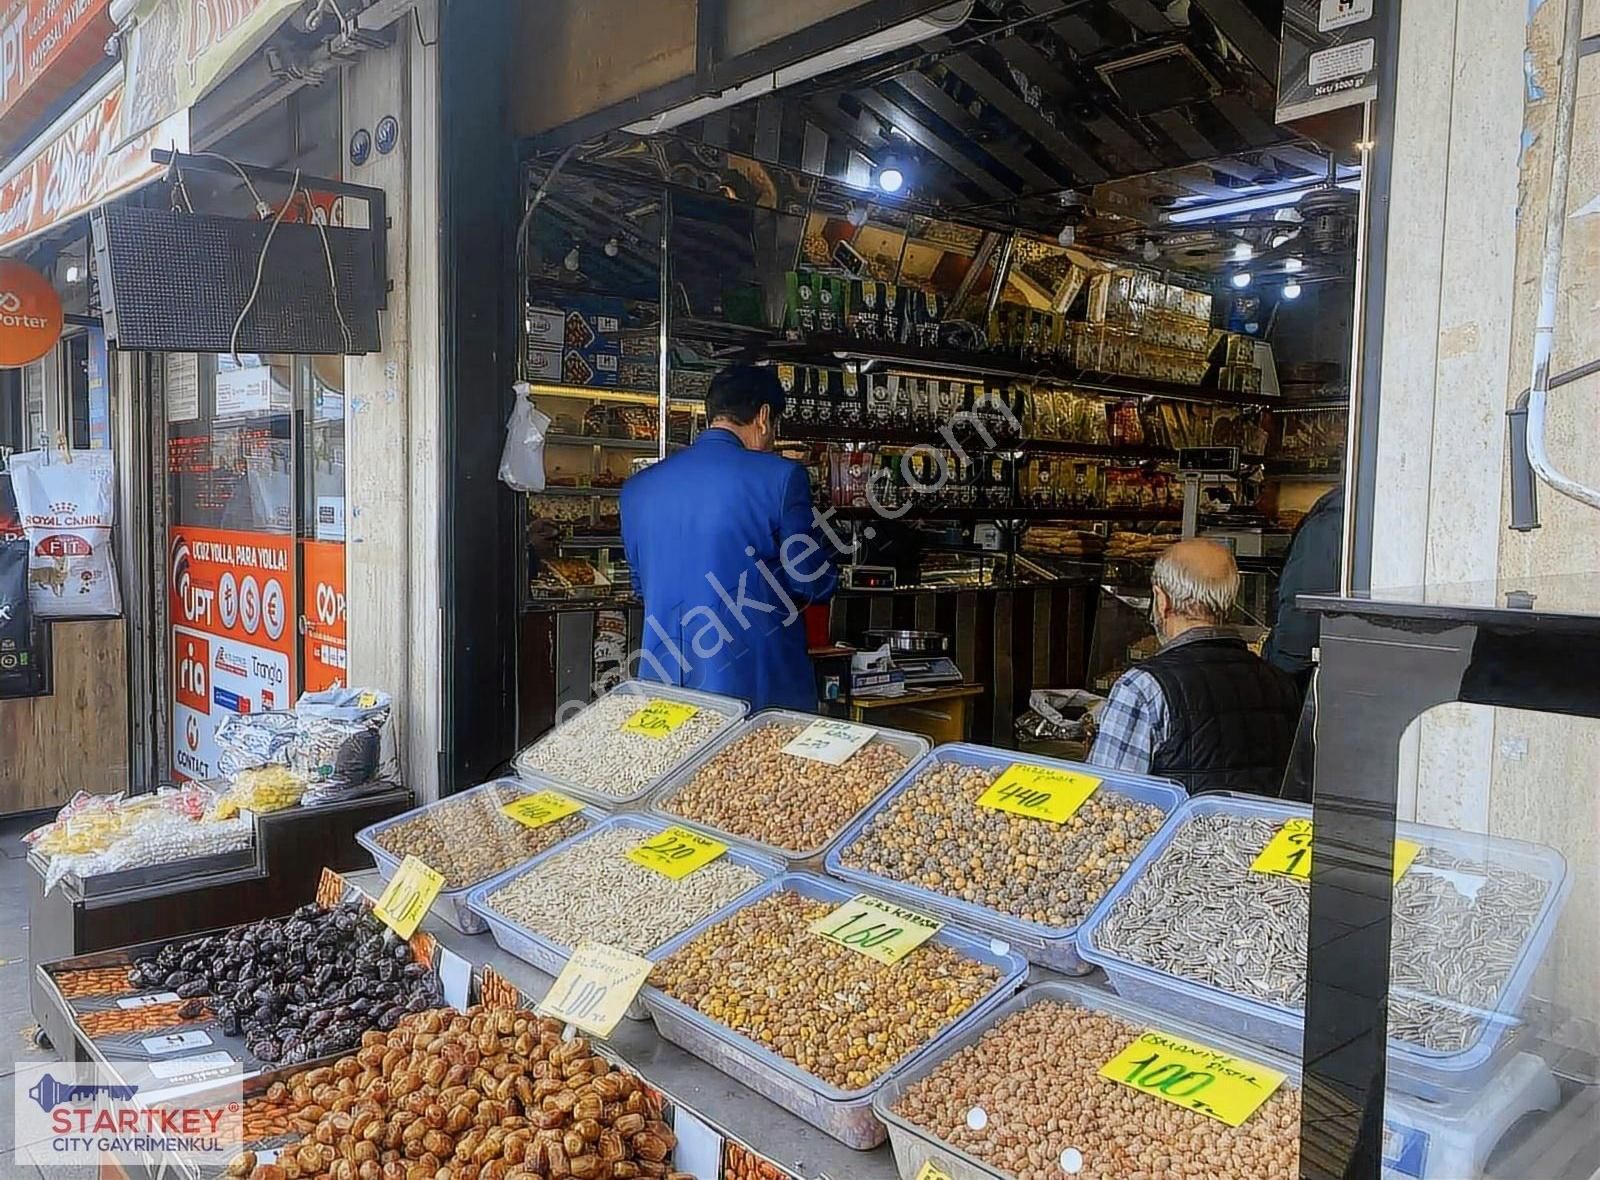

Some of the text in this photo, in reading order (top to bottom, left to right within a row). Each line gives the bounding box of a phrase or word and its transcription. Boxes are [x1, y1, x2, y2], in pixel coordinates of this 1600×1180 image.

[0, 5, 27, 102] PT
[0, 313, 48, 328] orter
[25, 514, 101, 526] ROYAL CANIN
[50, 541, 79, 554] FIT
[236, 545, 257, 568] PARA
[184, 585, 214, 626] UPT
[181, 642, 206, 697] ria
[177, 750, 209, 779] CONTACT
[997, 782, 1053, 808] 440
[820, 912, 904, 948] 160
[552, 973, 608, 1019] 100
[1124, 1053, 1216, 1097] 100
